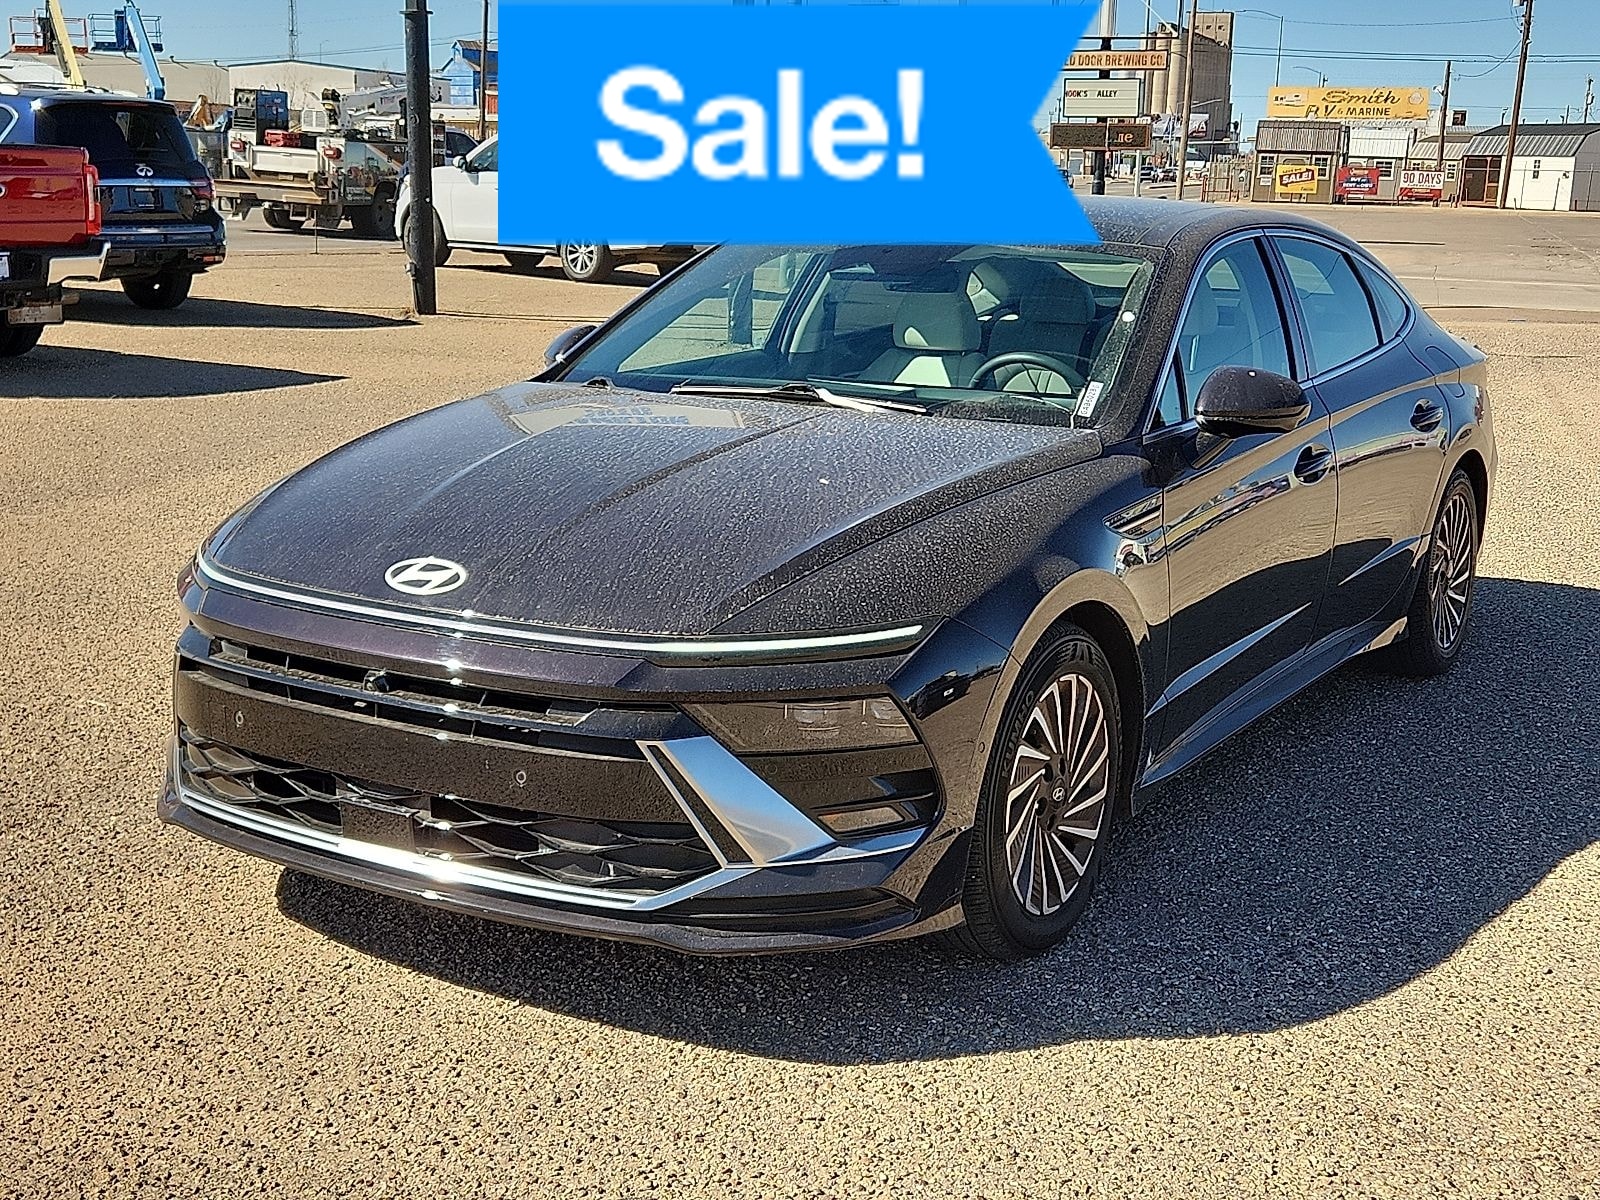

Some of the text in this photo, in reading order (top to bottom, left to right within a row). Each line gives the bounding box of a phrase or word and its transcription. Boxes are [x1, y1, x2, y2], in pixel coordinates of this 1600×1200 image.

[1078, 54, 1102, 65] DOOR
[1105, 54, 1147, 65] BREWING
[1150, 54, 1165, 66] CO.
[1097, 89, 1118, 98] ALLEY
[1322, 87, 1401, 105] Smith
[1345, 107, 1392, 116] MARINE
[1281, 171, 1313, 184] SALE!
[1403, 172, 1442, 185] 90 DAYS
[1001, 690, 1035, 778] KUMHO
